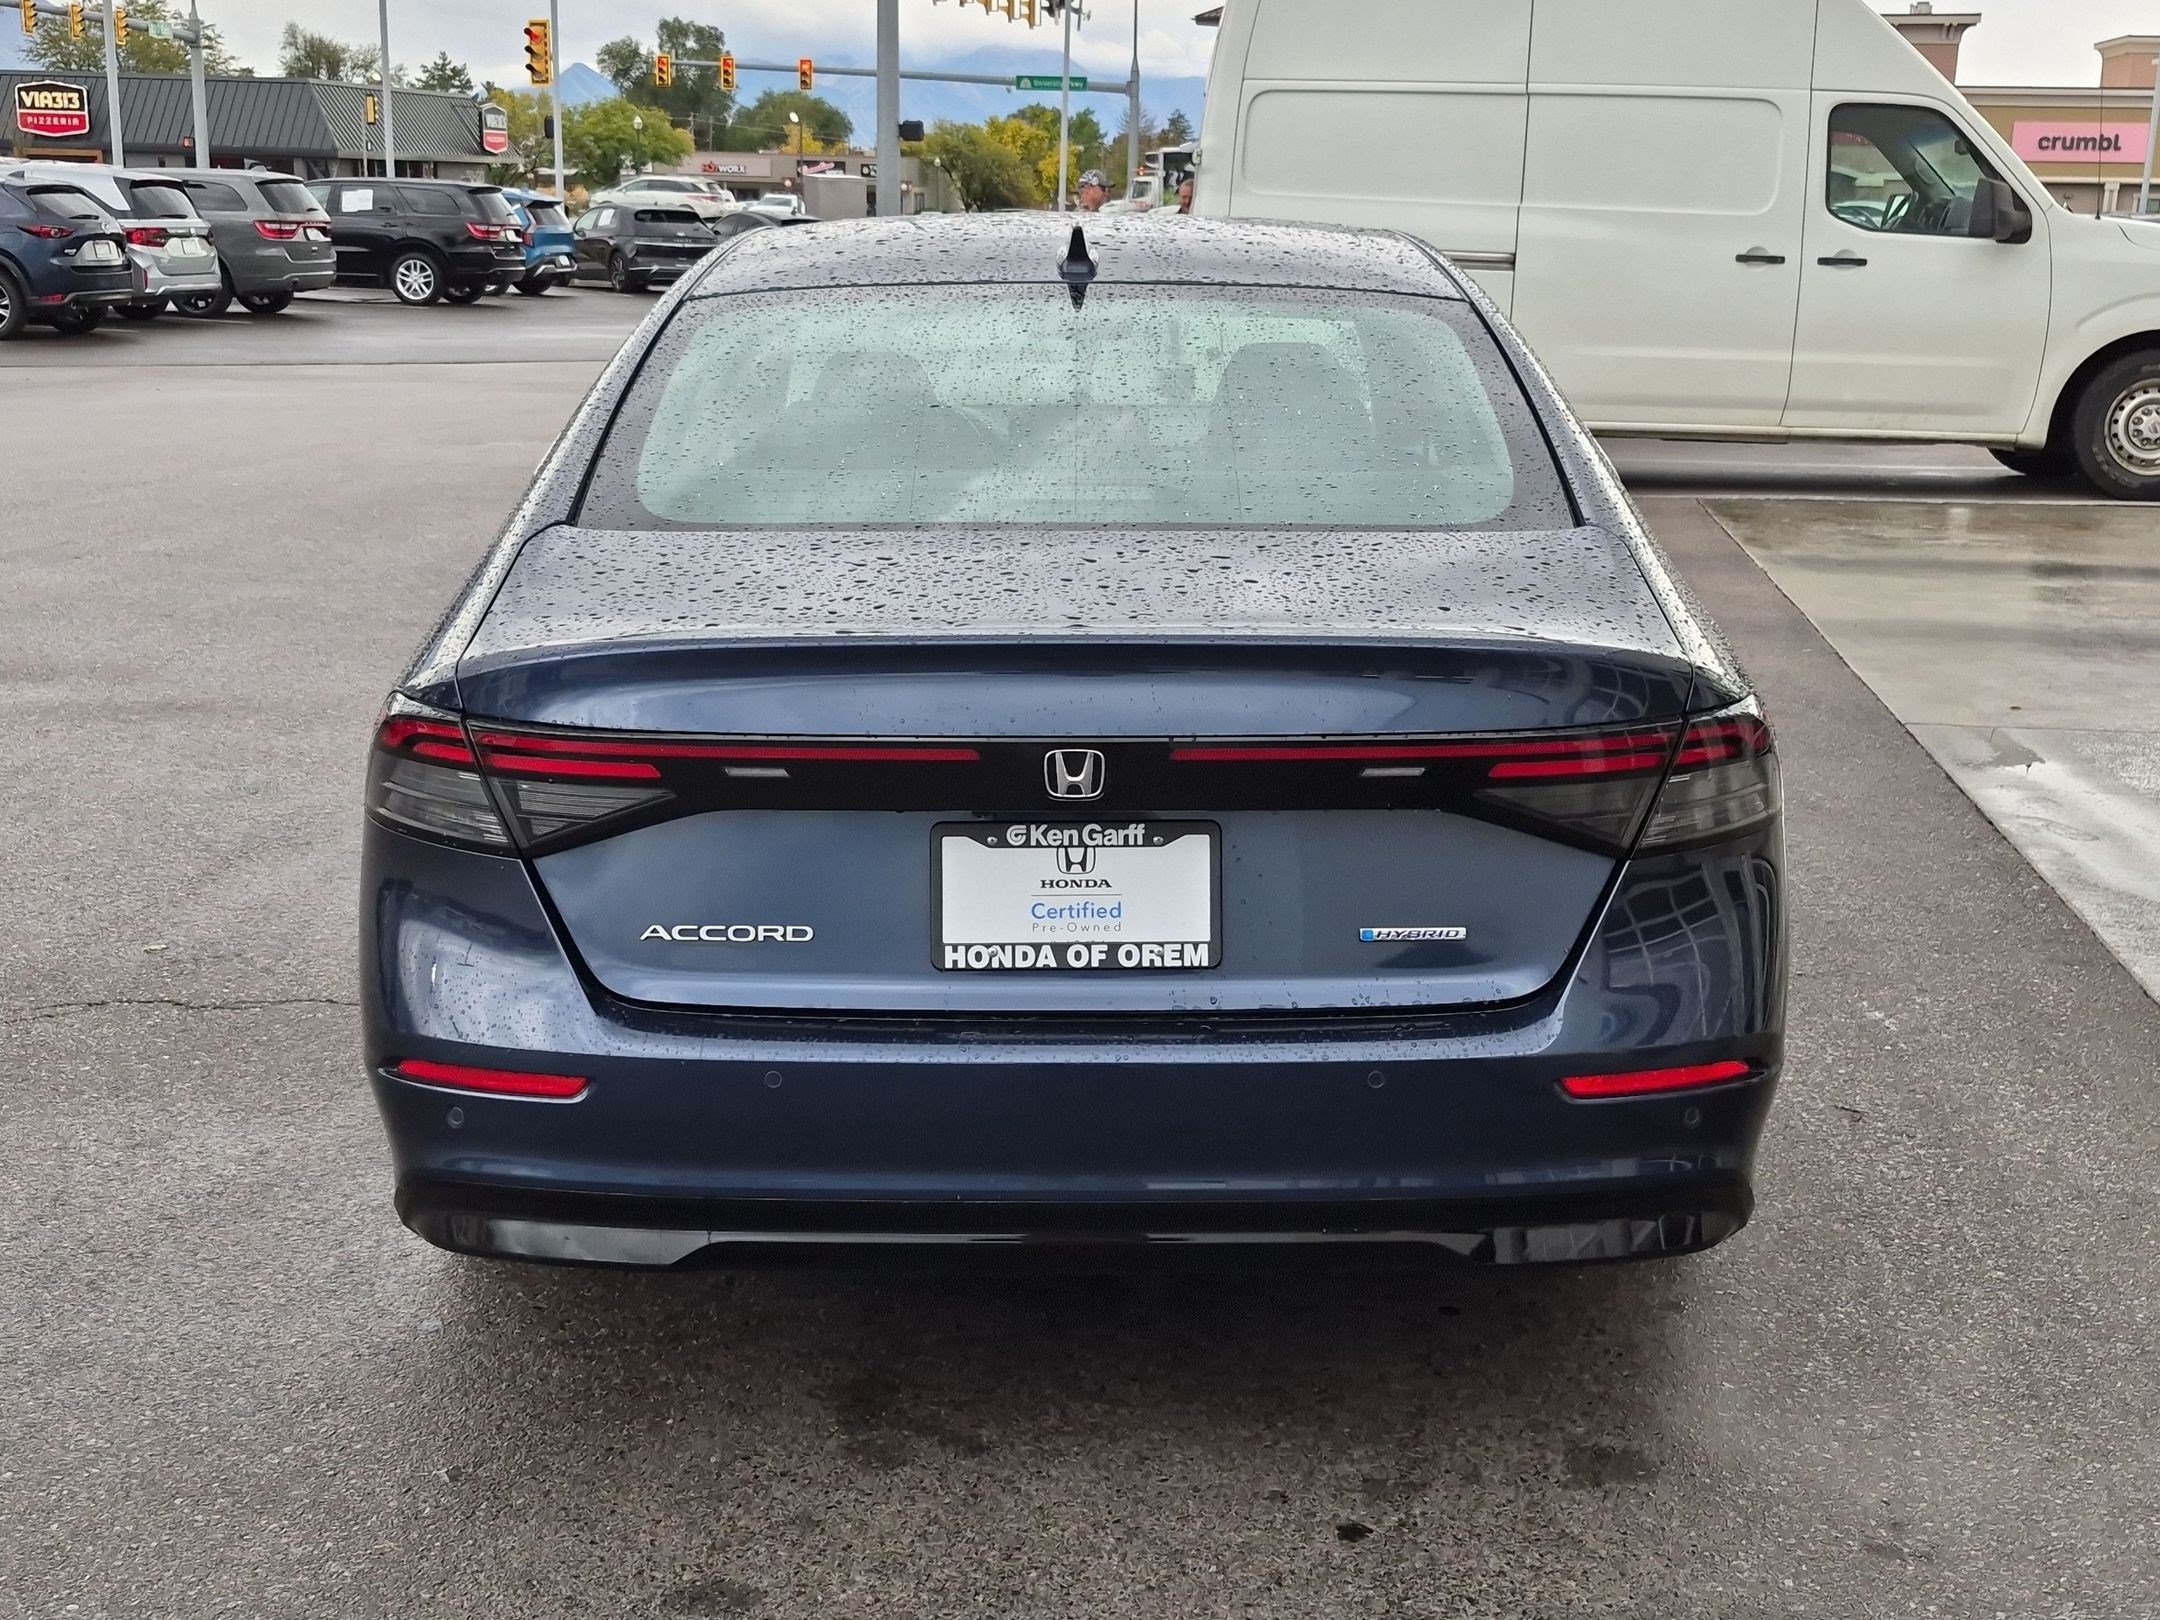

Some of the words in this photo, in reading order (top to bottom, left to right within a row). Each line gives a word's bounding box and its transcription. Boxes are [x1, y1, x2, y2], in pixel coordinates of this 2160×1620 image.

[27, 116, 80, 126] PIZZERIA
[2038, 134, 2122, 151] crumbl
[1030, 824, 1079, 846] Ken
[1082, 823, 1146, 846] Garff
[1040, 879, 1112, 889] HONDA
[1031, 901, 1122, 920] Certified
[639, 924, 814, 942] ACCORD
[1032, 921, 1122, 933] Pre-Owned
[1376, 929, 1460, 939] HYBRID
[944, 944, 1057, 969] HONDA
[1066, 944, 1107, 968] OF
[1117, 943, 1209, 968] OREM
